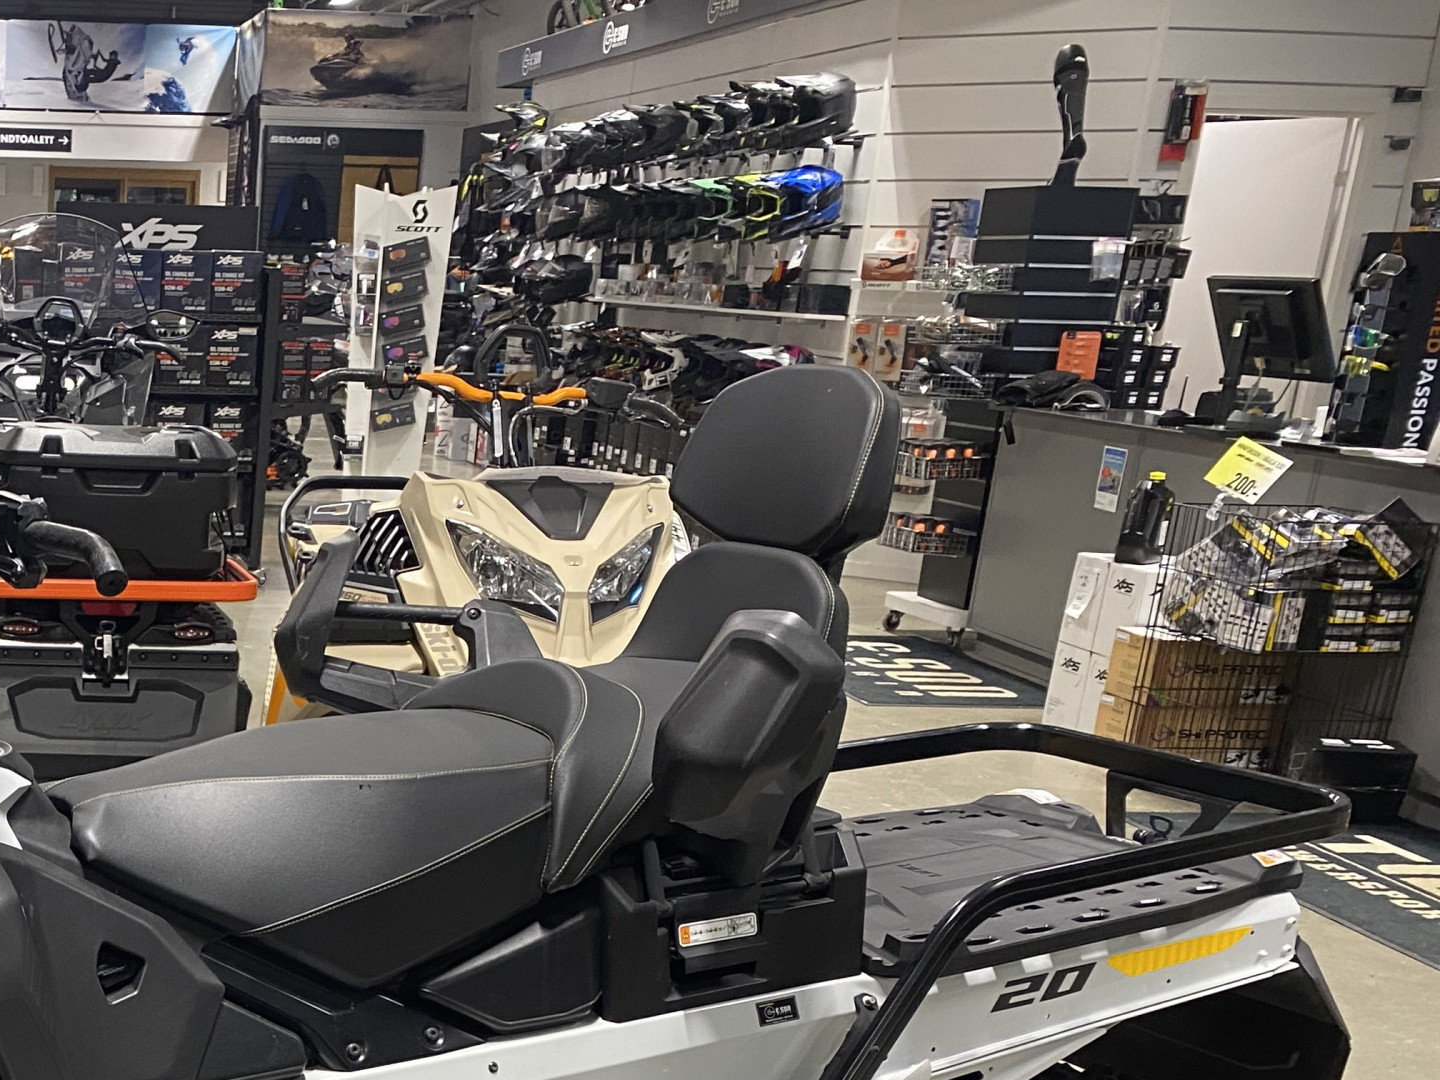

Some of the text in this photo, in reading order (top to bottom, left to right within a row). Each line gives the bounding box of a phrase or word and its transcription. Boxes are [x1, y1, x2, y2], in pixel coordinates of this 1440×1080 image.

[114, 217, 204, 252] XPS
[395, 225, 443, 233] SCOTT
[166, 253, 194, 265] XPS
[216, 254, 245, 265] XPS
[211, 329, 238, 340] XPS
[1402, 358, 1439, 448] PASSION
[158, 405, 186, 416] XPS
[214, 406, 241, 417] XPS
[1113, 578, 1135, 593] XPS
[1061, 657, 1082, 672] XPS
[990, 961, 1097, 1014] 20
